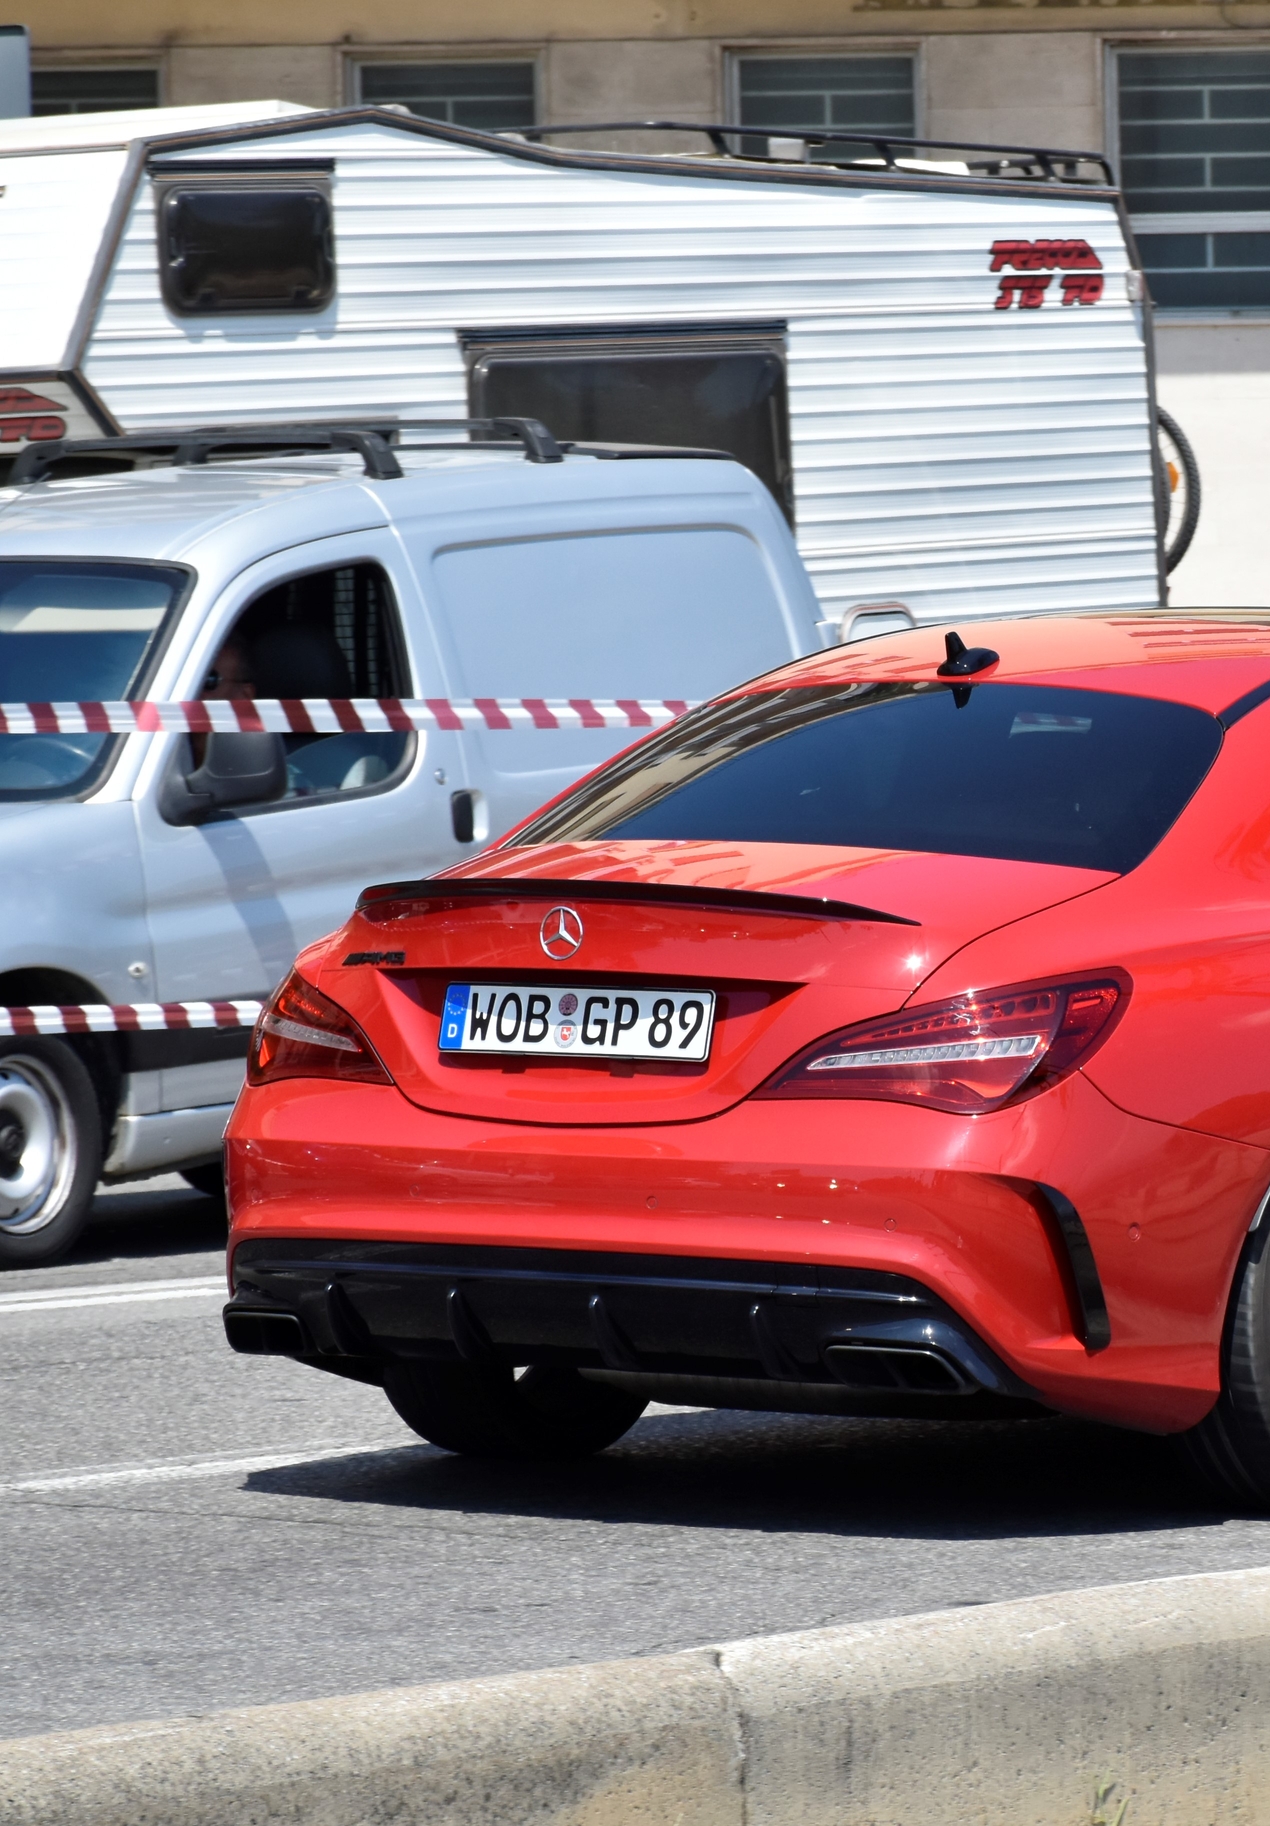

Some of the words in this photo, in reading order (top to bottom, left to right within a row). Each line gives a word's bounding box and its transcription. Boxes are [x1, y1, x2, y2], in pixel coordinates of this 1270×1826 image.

[448, 1023, 458, 1039] D
[469, 992, 551, 1043] WOB
[581, 996, 639, 1047] GP
[648, 998, 705, 1050] 89
